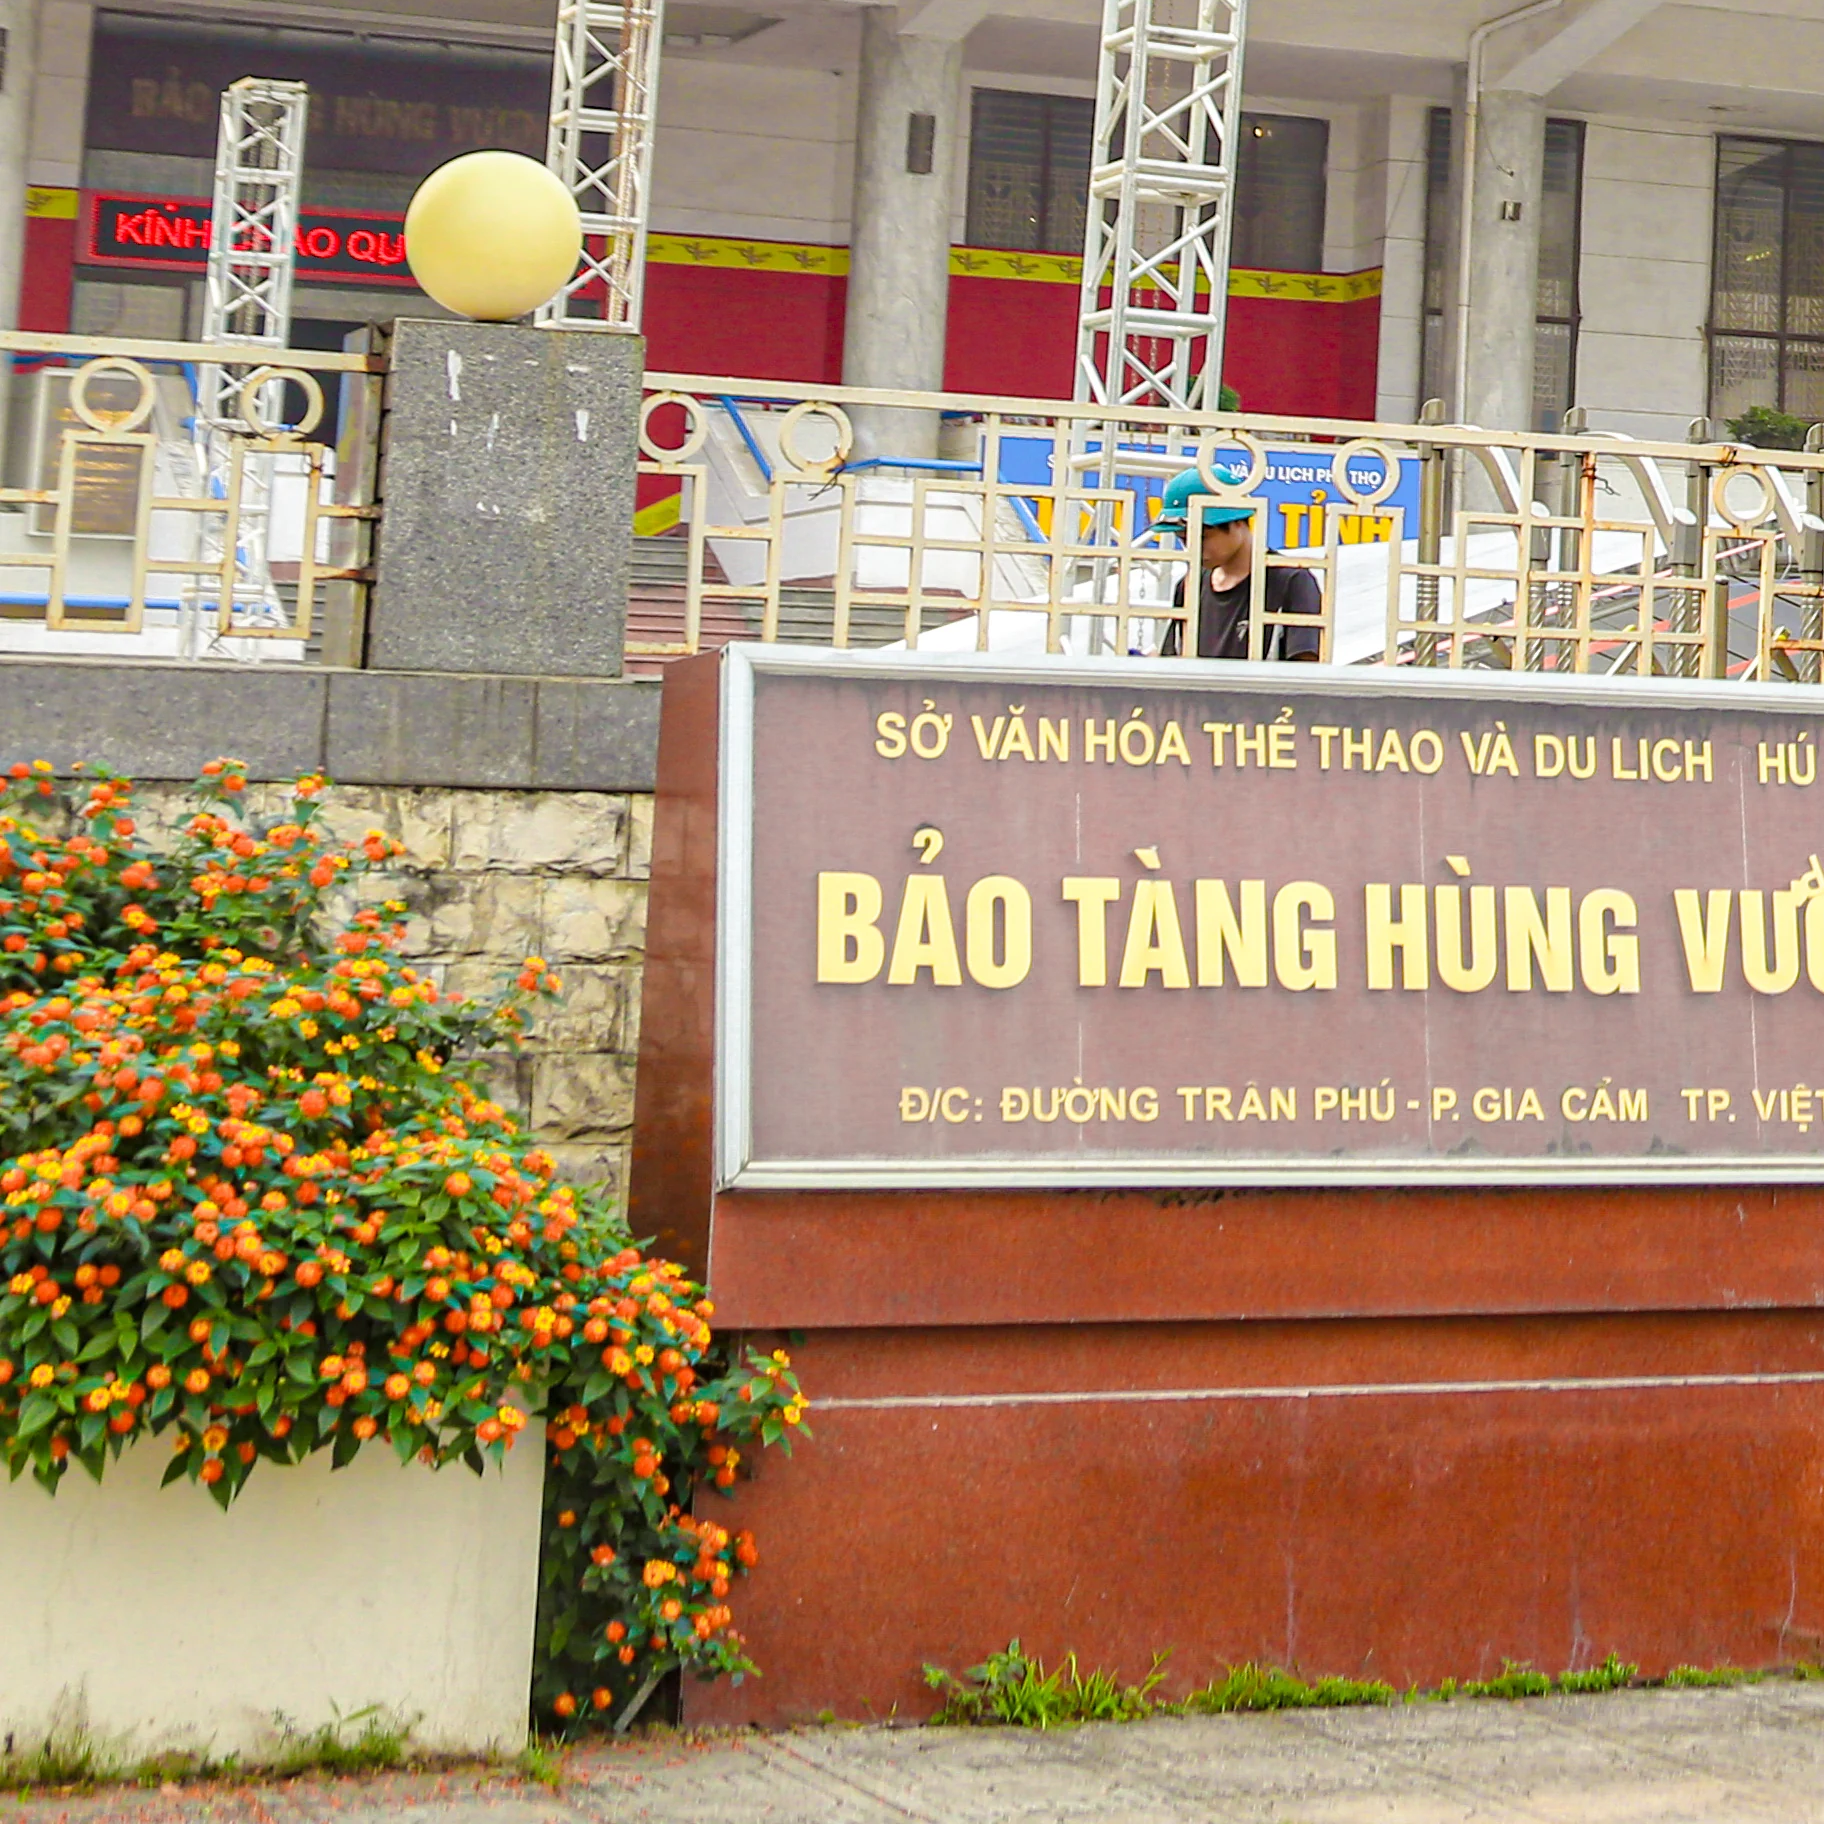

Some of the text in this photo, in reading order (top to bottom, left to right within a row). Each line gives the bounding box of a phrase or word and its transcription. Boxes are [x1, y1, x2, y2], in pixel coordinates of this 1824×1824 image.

[1278, 466, 1315, 485] LỊCH
[1349, 469, 1383, 489] THỌ
[1278, 488, 1394, 549] TỈNH
[875, 698, 953, 760] SỞ
[971, 704, 1070, 763] VĂN
[1084, 707, 1192, 768] HÓA
[1203, 706, 1298, 770] THỂ
[1310, 724, 1444, 775] THAO
[1460, 721, 1519, 778] VÀ
[1533, 734, 1597, 780] DU
[1611, 737, 1714, 784] LICH
[817, 827, 1033, 989] BẢO
[1061, 845, 1337, 991] TÀNG
[1365, 855, 1641, 995] HÙNG
[899, 1086, 984, 1123] Đ/C:
[1000, 1077, 1161, 1124] ĐƯỜNG
[1314, 1078, 1396, 1123] PHÚ
[1431, 1087, 1460, 1122] P.
[1472, 1087, 1545, 1122] GIA
[1680, 1088, 1737, 1123] TP.
